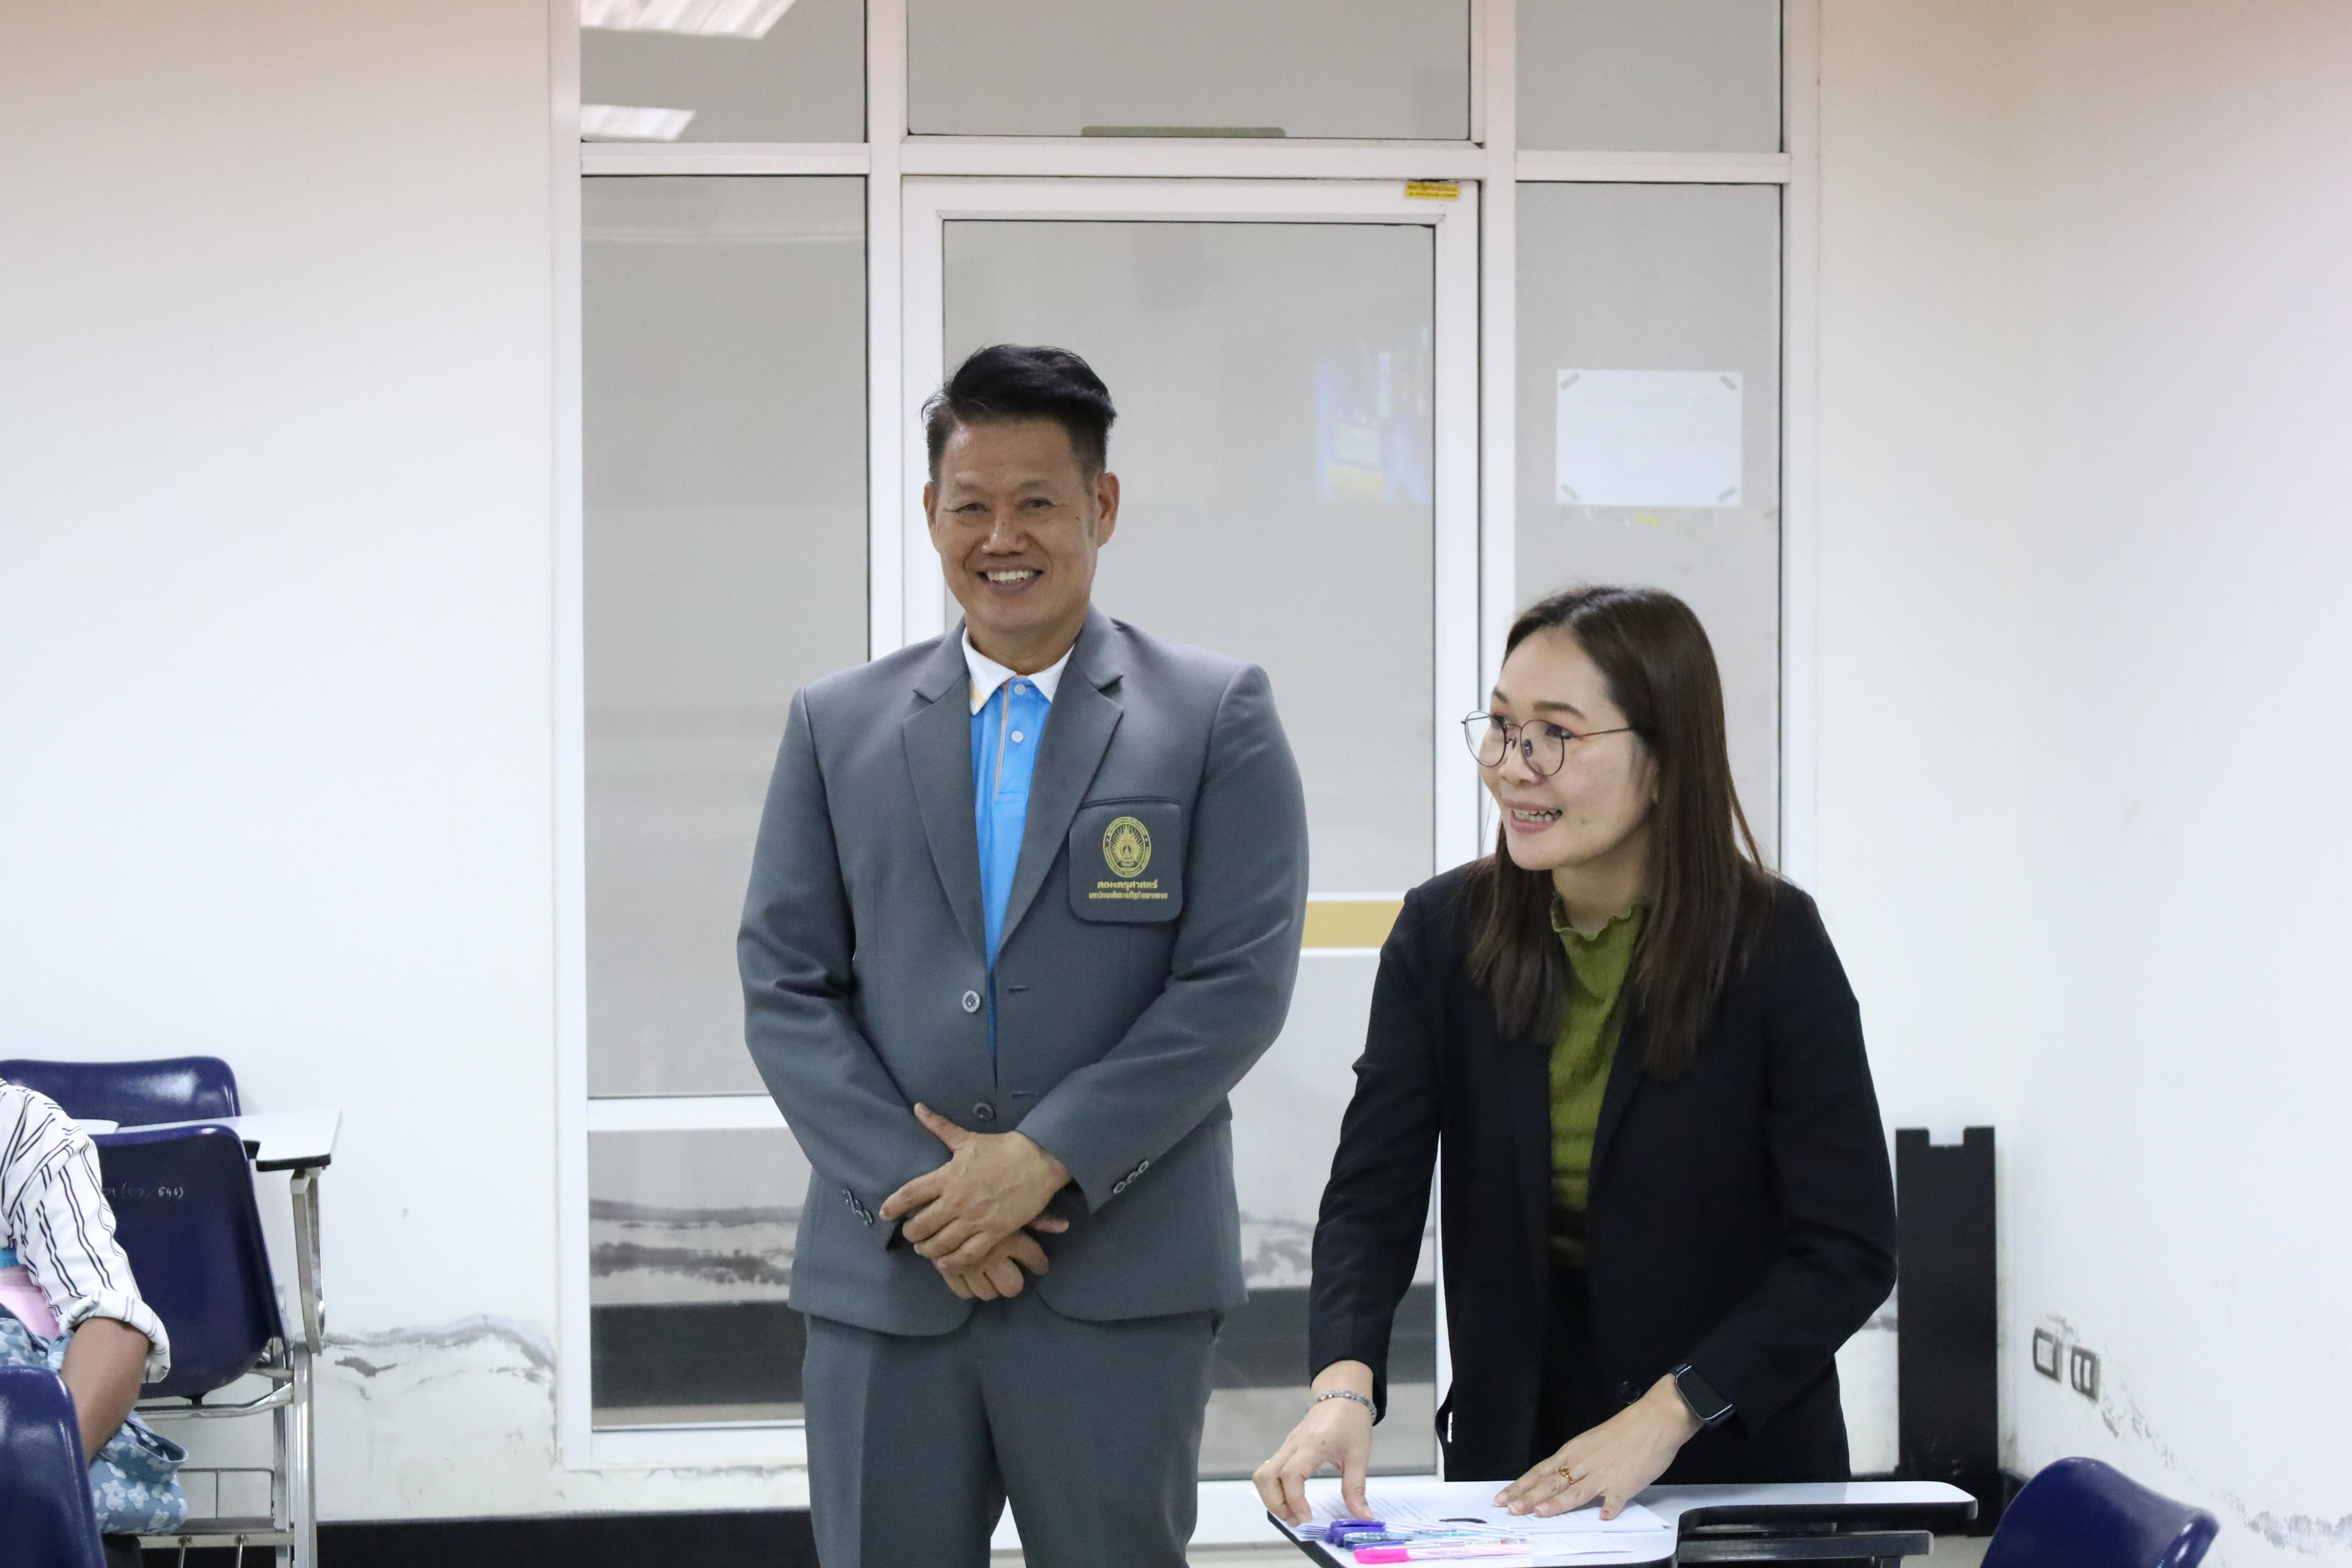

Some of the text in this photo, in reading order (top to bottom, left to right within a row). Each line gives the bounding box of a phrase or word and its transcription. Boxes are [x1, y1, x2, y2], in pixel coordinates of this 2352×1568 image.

[1098, 879, 1158, 891] คณะครุศาสตร์
